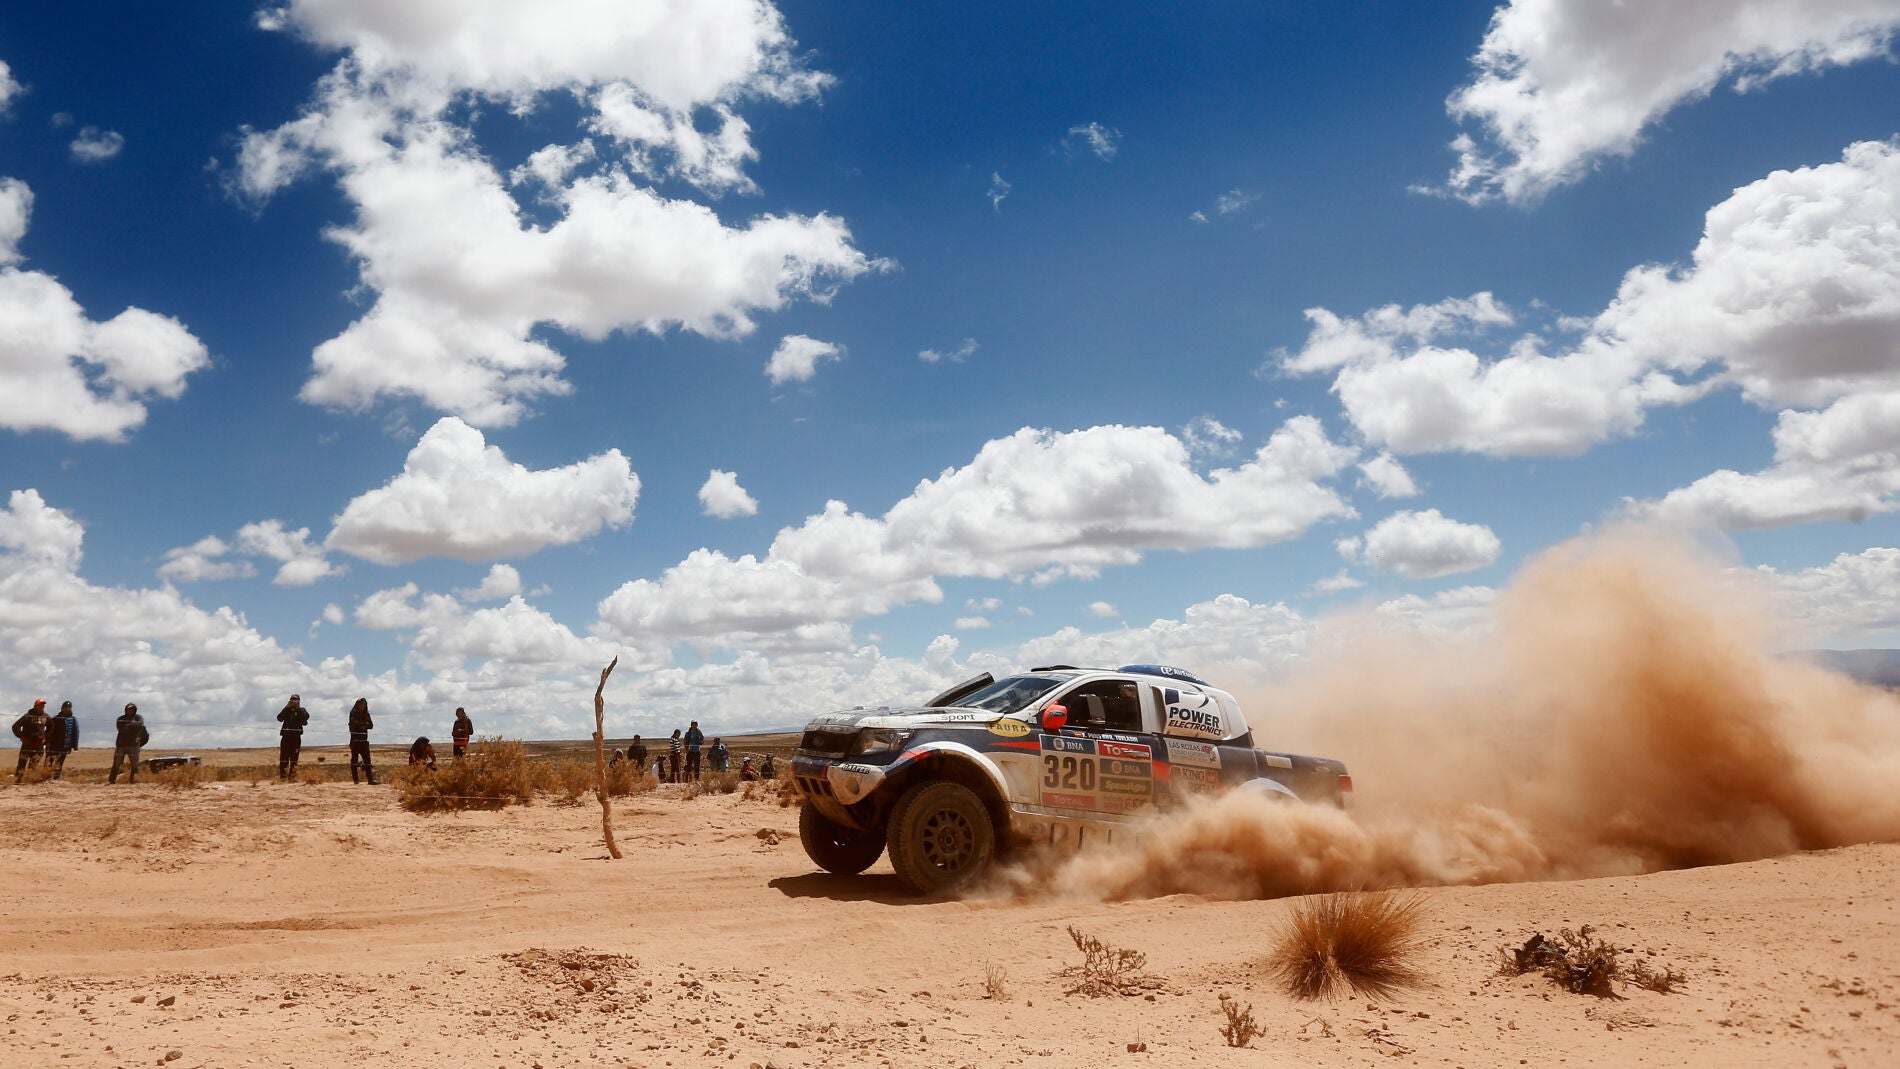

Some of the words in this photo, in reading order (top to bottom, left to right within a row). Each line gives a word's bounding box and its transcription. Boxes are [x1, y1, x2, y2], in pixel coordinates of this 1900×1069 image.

[941, 714, 976, 723] sport
[1169, 706, 1220, 728] POWER
[989, 722, 1028, 733] FAURA
[1168, 719, 1222, 736] ELECTRONICS
[1066, 742, 1085, 751] BNA
[841, 764, 871, 775] GALFER
[1044, 754, 1096, 791] 320
